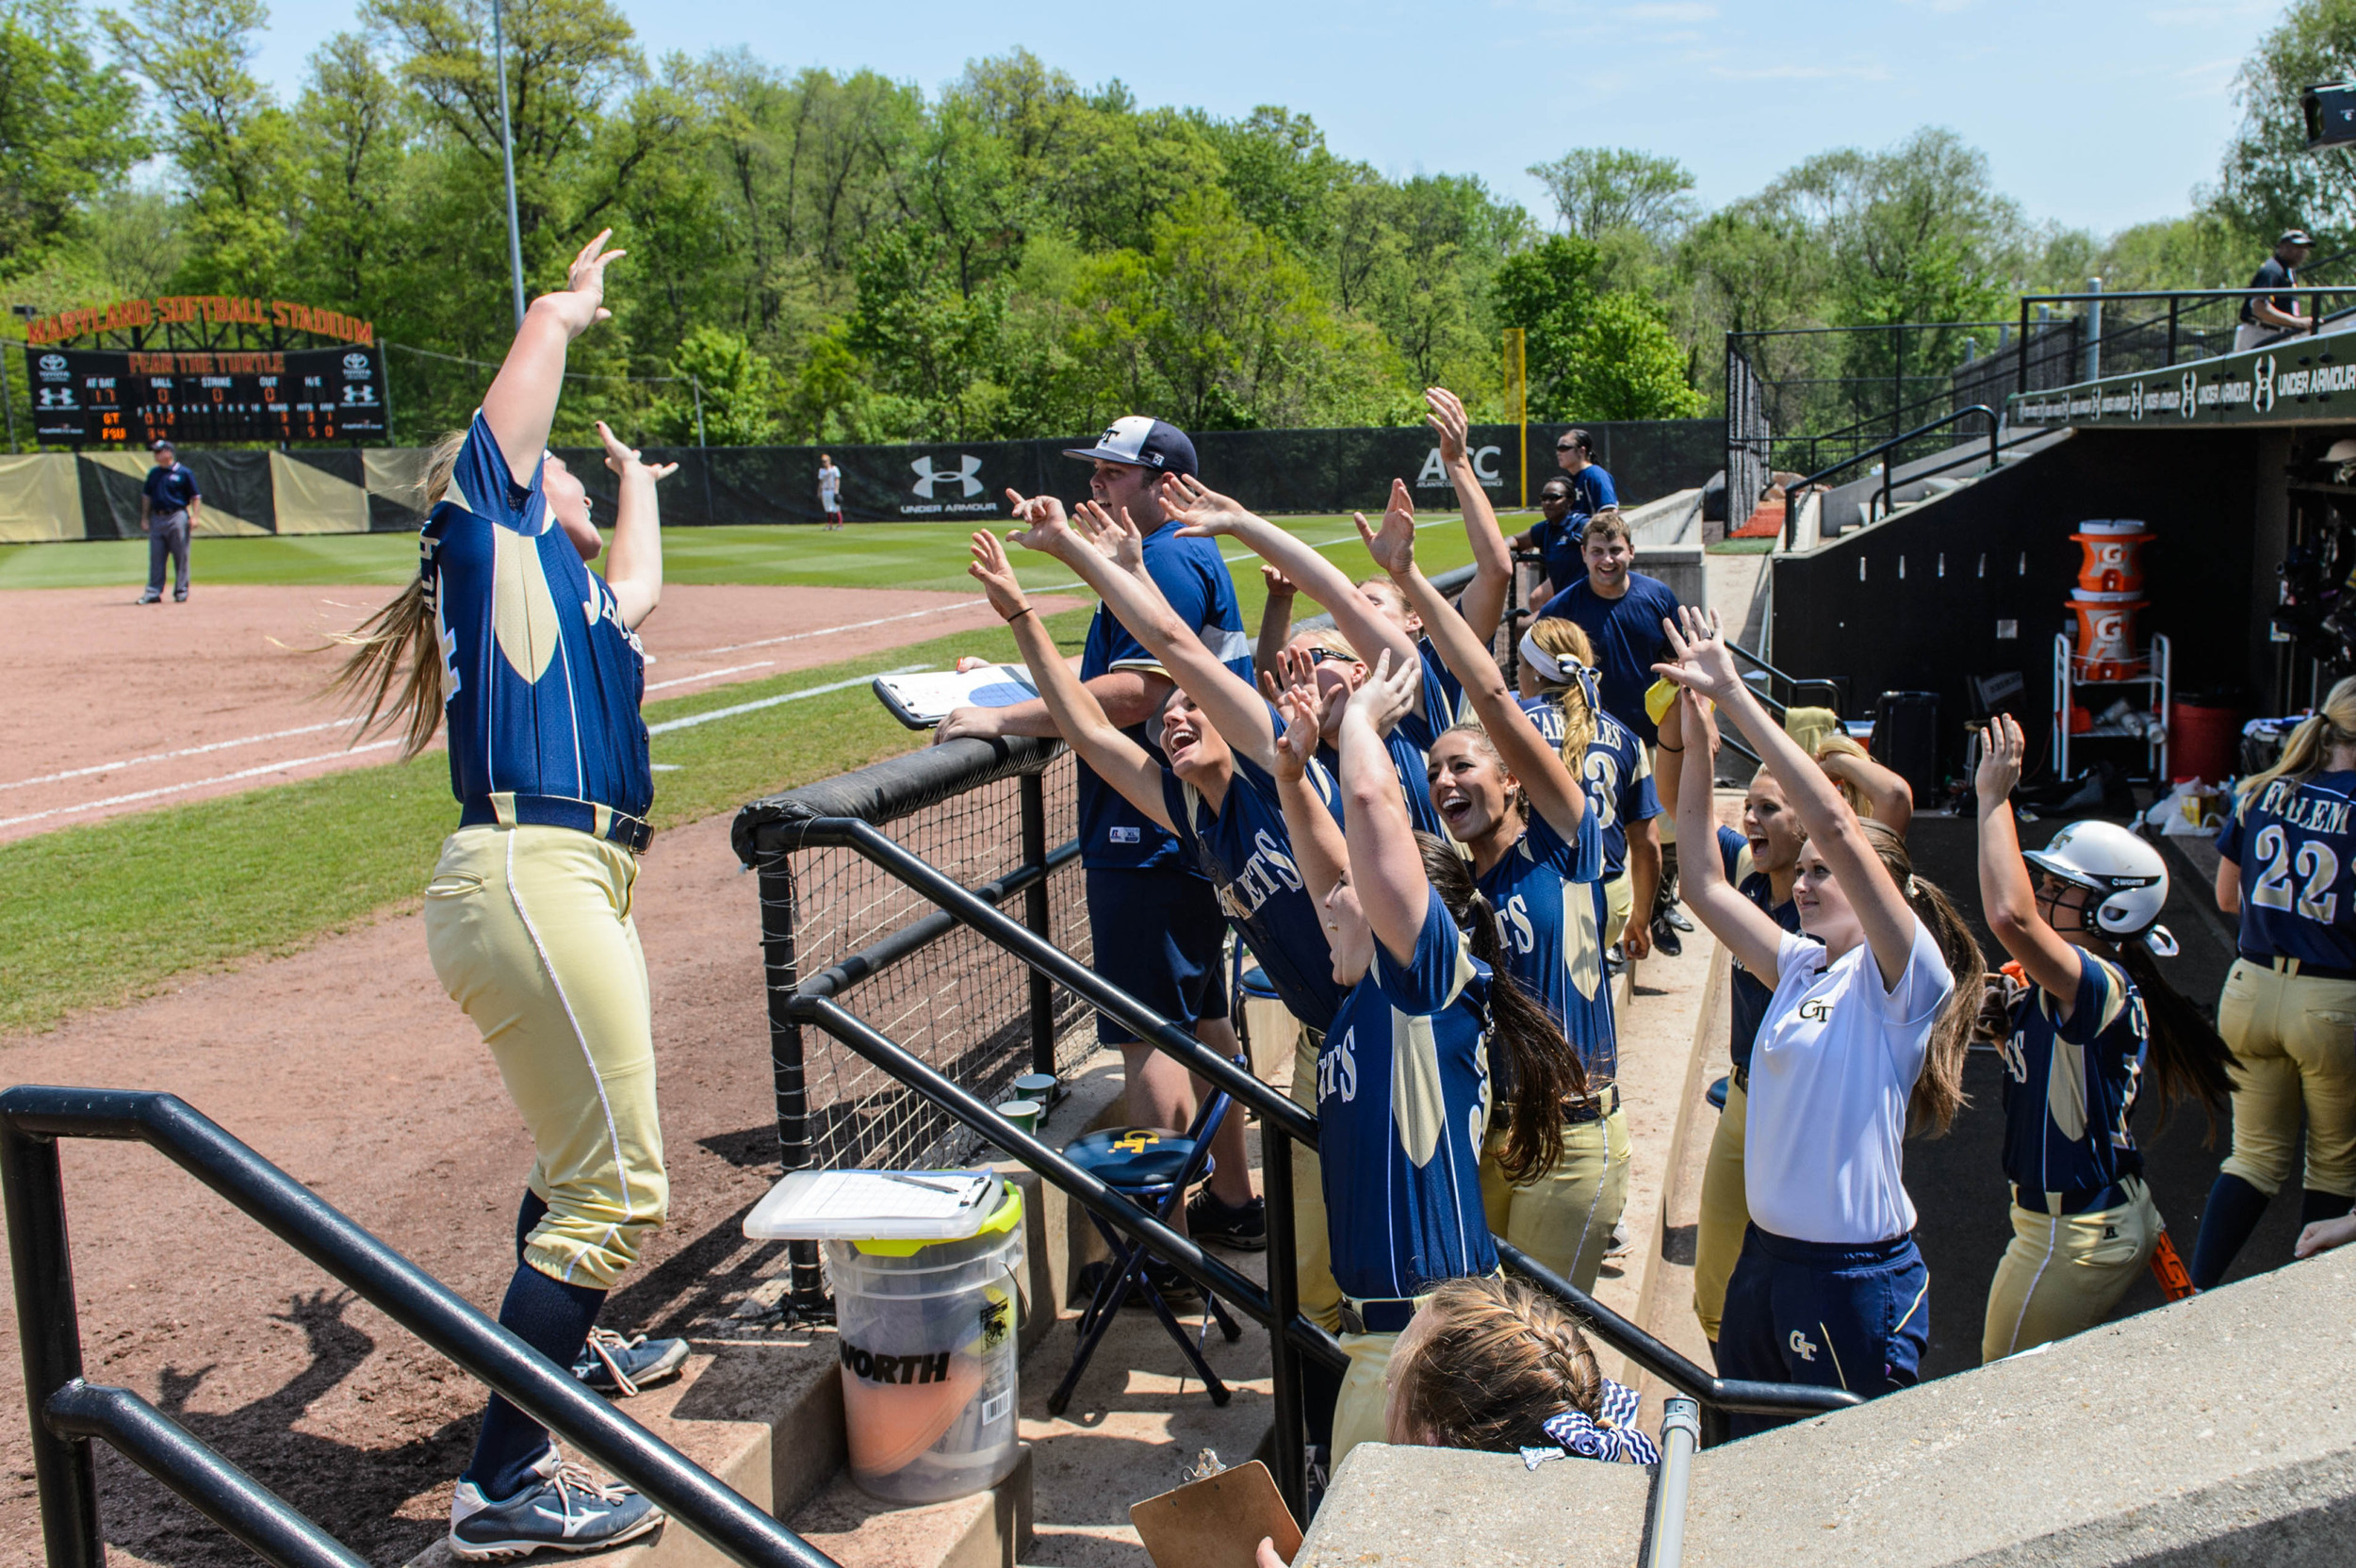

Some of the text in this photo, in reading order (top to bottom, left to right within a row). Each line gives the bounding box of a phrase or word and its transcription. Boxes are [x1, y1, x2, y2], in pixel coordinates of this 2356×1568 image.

[25, 296, 374, 348] MARYLAND SOFTBALL STADIUM
[129, 352, 285, 374] FEAR THE TURTLE
[151, 377, 173, 388] BALL
[202, 376, 233, 387] STRIKE
[259, 376, 279, 387] OUT
[2219, 381, 2251, 403] ARMOUR
[2278, 365, 2356, 397] UNDER ARMOUR
[1416, 446, 1501, 481] AC
[900, 502, 997, 514] UNDER ARMOUR
[2102, 544, 2122, 564] G
[2097, 615, 2121, 643] G
[2251, 824, 2339, 925] 22
[1799, 999, 1835, 1022] GT
[840, 1336, 951, 1385] WORTH
[1790, 1330, 1818, 1363] GT
